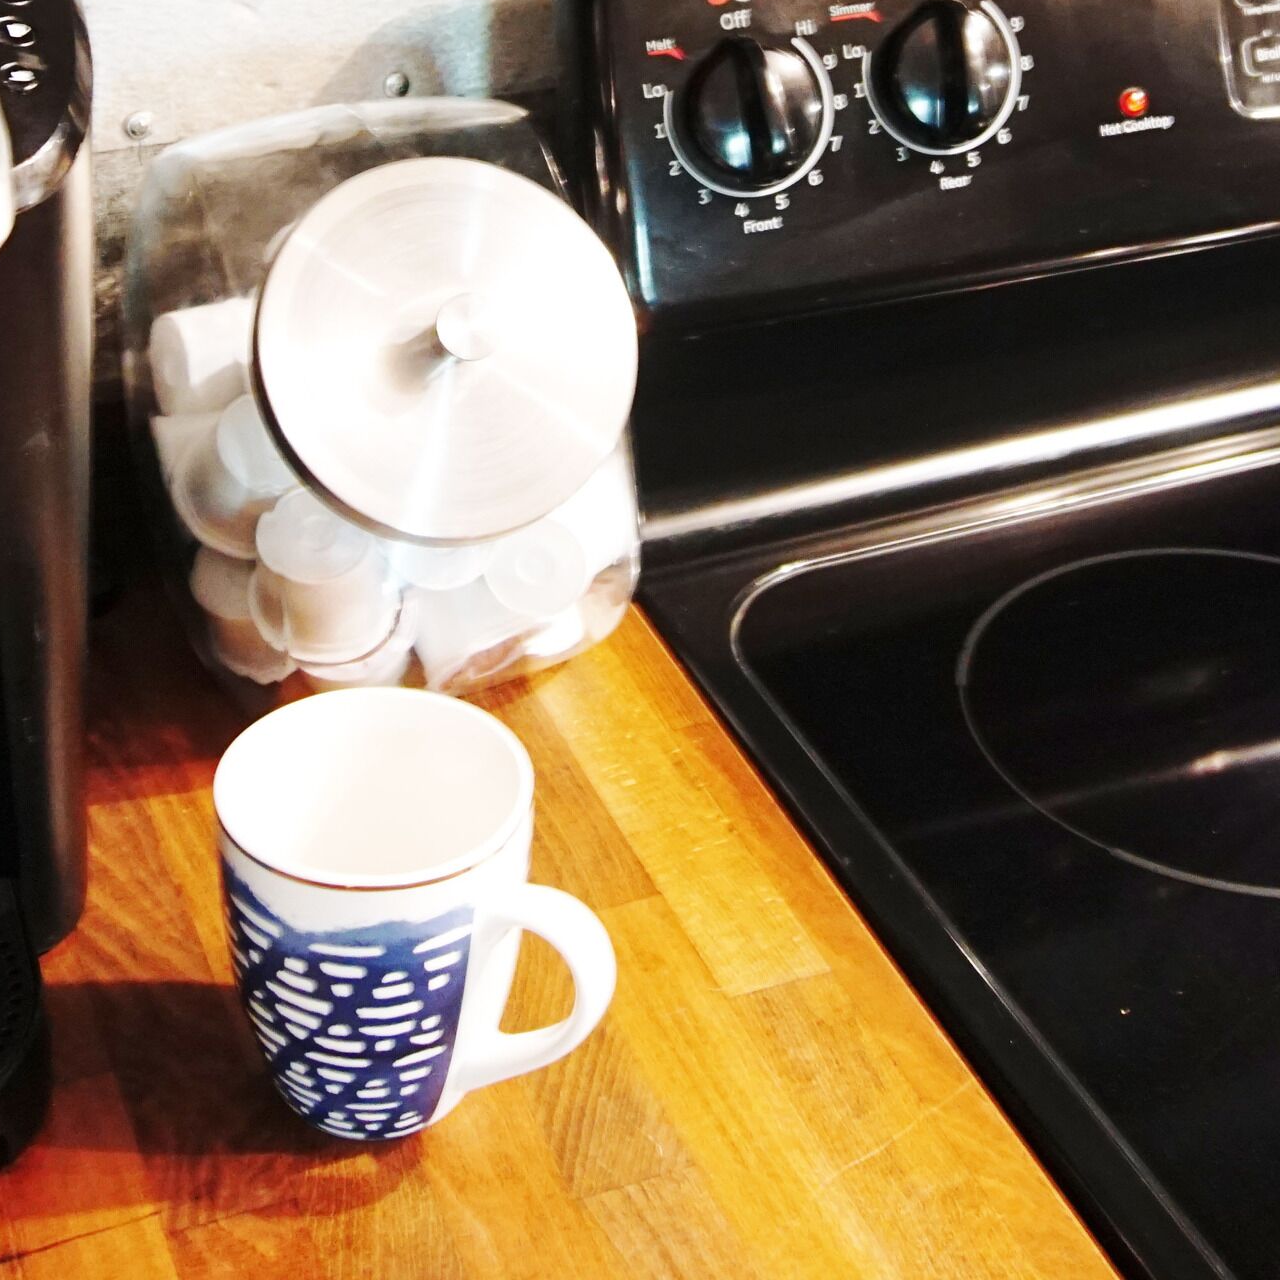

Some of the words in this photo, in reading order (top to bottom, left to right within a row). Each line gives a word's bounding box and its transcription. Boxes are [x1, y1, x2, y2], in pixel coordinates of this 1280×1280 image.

[828, 1, 874, 16] Simmer
[720, 9, 752, 30] Off
[795, 19, 817, 36] Hi
[1010, 16, 1024, 32] 9
[645, 38, 675, 52] Melt
[842, 44, 866, 59] Lo
[823, 53, 838, 70] 9
[1020, 55, 1034, 71] 8
[642, 83, 667, 99] Lo
[854, 83, 866, 98] 1
[833, 94, 848, 110] 8
[1016, 95, 1030, 111] 7
[654, 123, 667, 139] 1
[868, 120, 881, 135] 2
[1099, 123, 1121, 136] Hot
[1123, 115, 1175, 133] Cooktop
[830, 135, 843, 152] 7
[996, 128, 1012, 145] 6
[896, 147, 909, 162] 3
[966, 151, 982, 168] 5
[669, 160, 682, 176] 2
[929, 160, 945, 175] 4
[807, 170, 823, 186] 6
[939, 175, 973, 190] Rear
[697, 189, 712, 205] 3
[774, 193, 790, 210] 5
[734, 203, 750, 217] 4
[743, 216, 783, 234] Front
